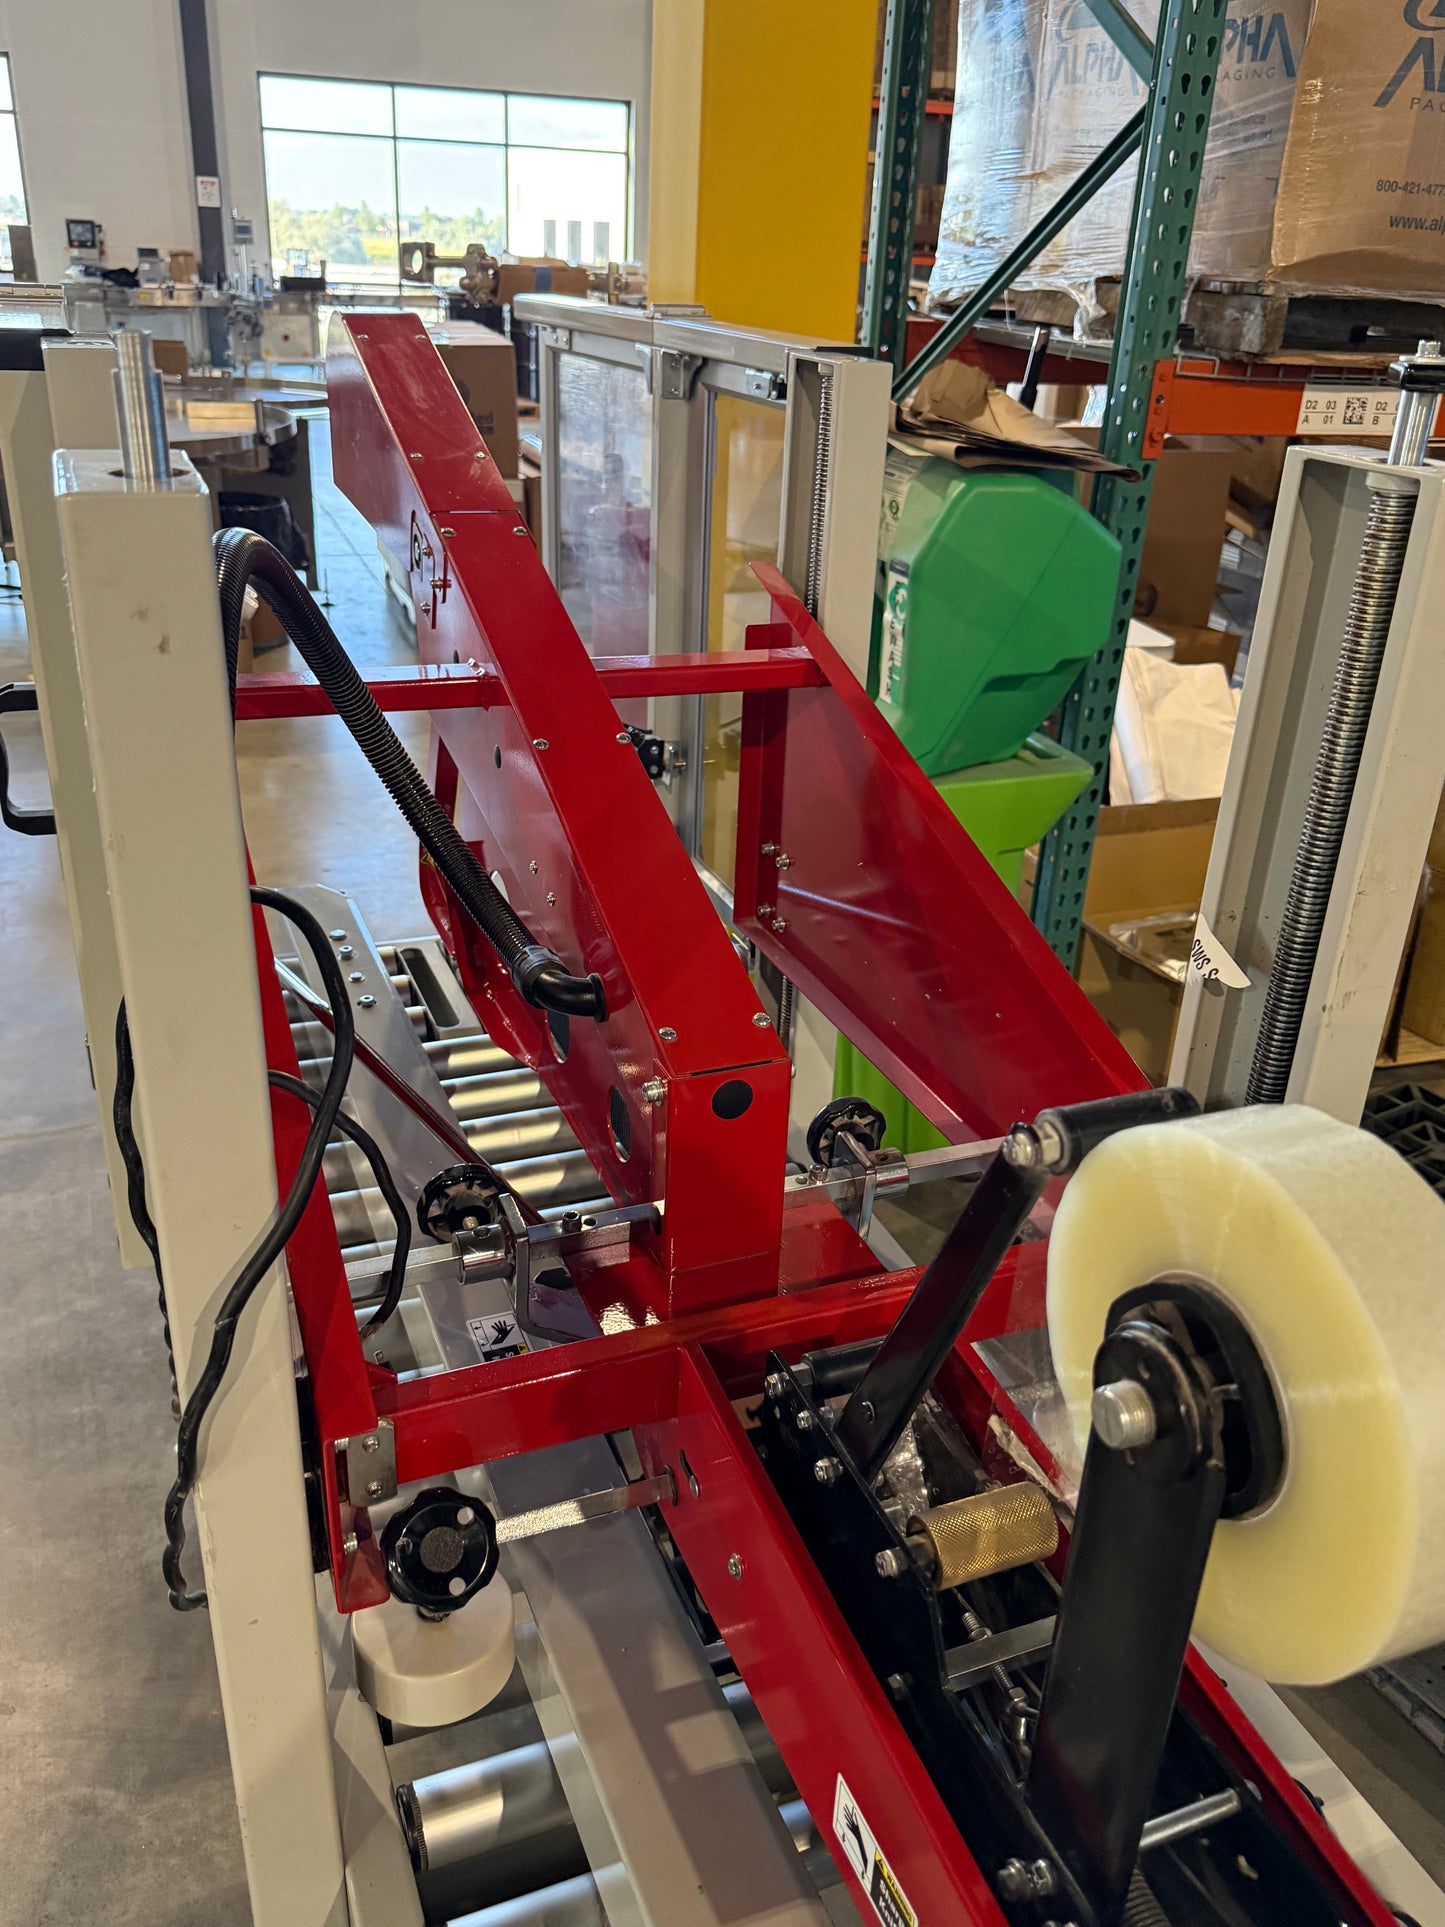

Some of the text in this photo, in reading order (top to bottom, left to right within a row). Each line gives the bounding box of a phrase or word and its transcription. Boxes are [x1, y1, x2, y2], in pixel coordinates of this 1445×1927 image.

[1220, 12, 1296, 78] PHA
[1216, 67, 1276, 81] AGING
[1376, 179, 1445, 197] 800-421-477
[1305, 400, 1337, 410] D2 03
[1375, 401, 1388, 411] D2
[1301, 415, 1334, 424] A 01
[1372, 416, 1379, 425] B
